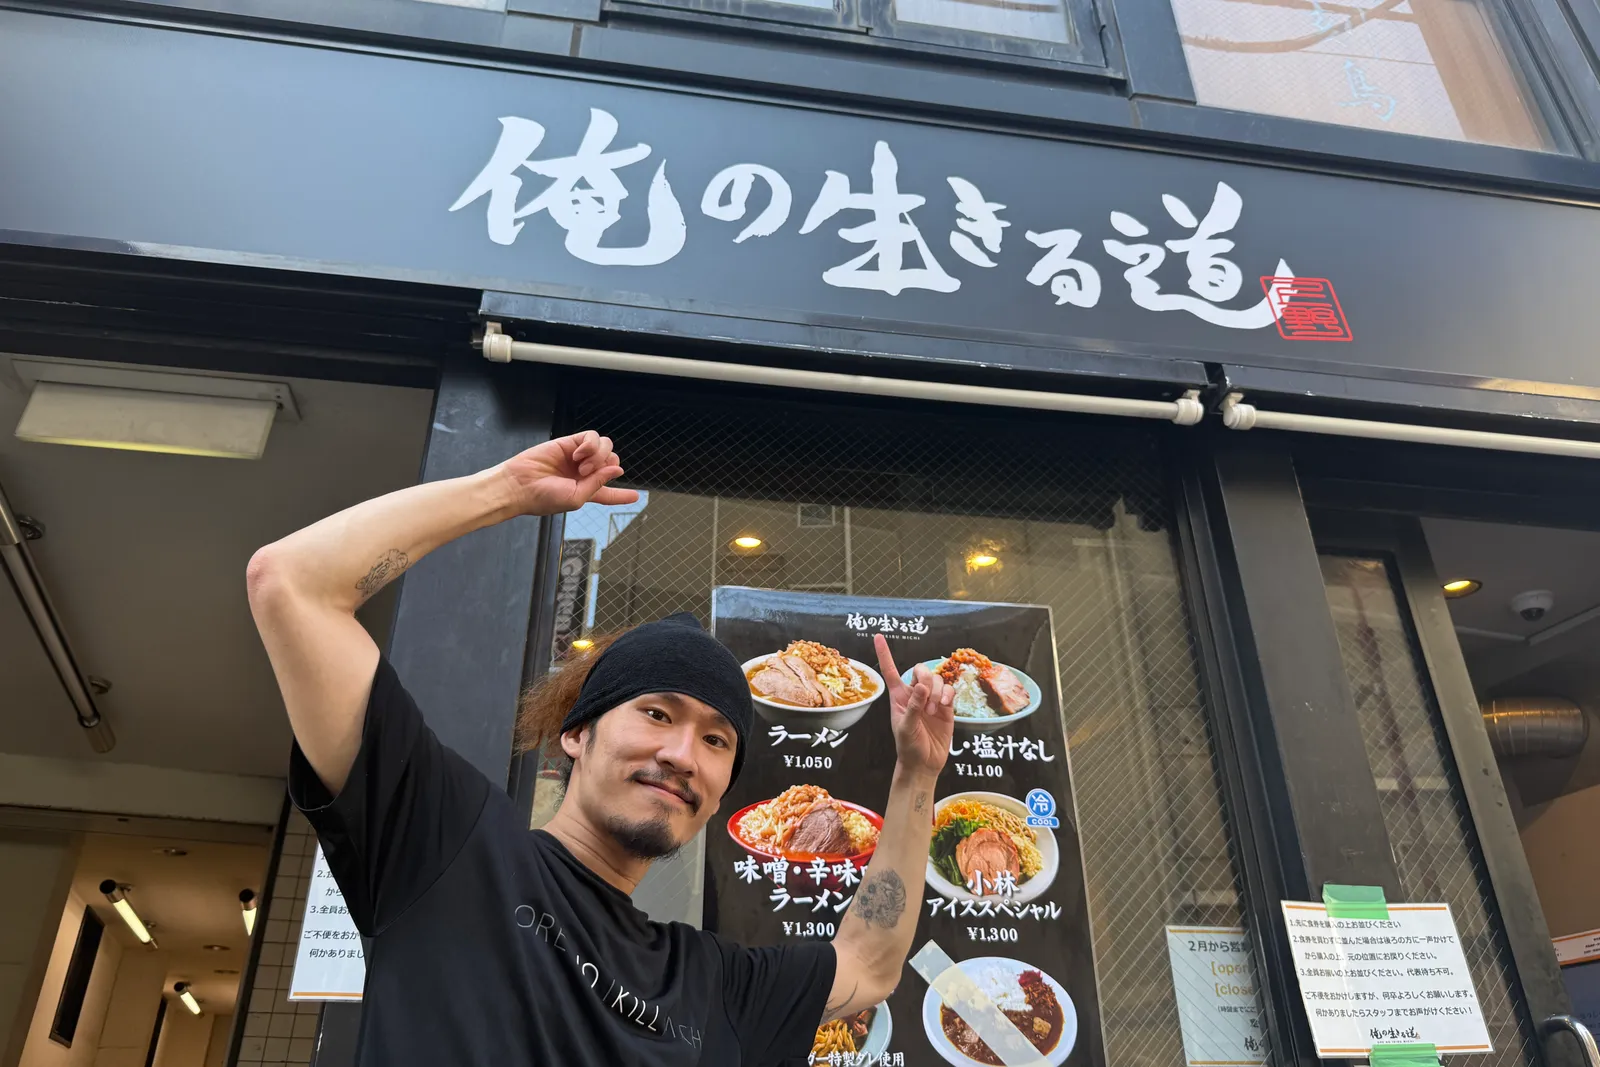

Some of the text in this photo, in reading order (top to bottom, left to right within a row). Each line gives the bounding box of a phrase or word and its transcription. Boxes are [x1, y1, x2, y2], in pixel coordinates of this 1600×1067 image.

[448, 107, 1296, 330] 俺の生きる道
[845, 612, 929, 634] 俺の生きる道
[767, 724, 849, 749] ラーメン
[783, 754, 832, 769] ¥1,050
[955, 762, 1003, 777] ¥1,100
[1031, 793, 1050, 813] 冷
[1031, 817, 1053, 826] COOL
[733, 854, 868, 888] 味噌・辛味
[967, 869, 1021, 897] 小林
[769, 887, 853, 914] ラーメン
[926, 897, 1062, 921] アイススペシャル
[782, 921, 836, 937] ¥1,300
[967, 926, 1019, 942] ¥1,300
[309, 948, 364, 959] 何かありまし
